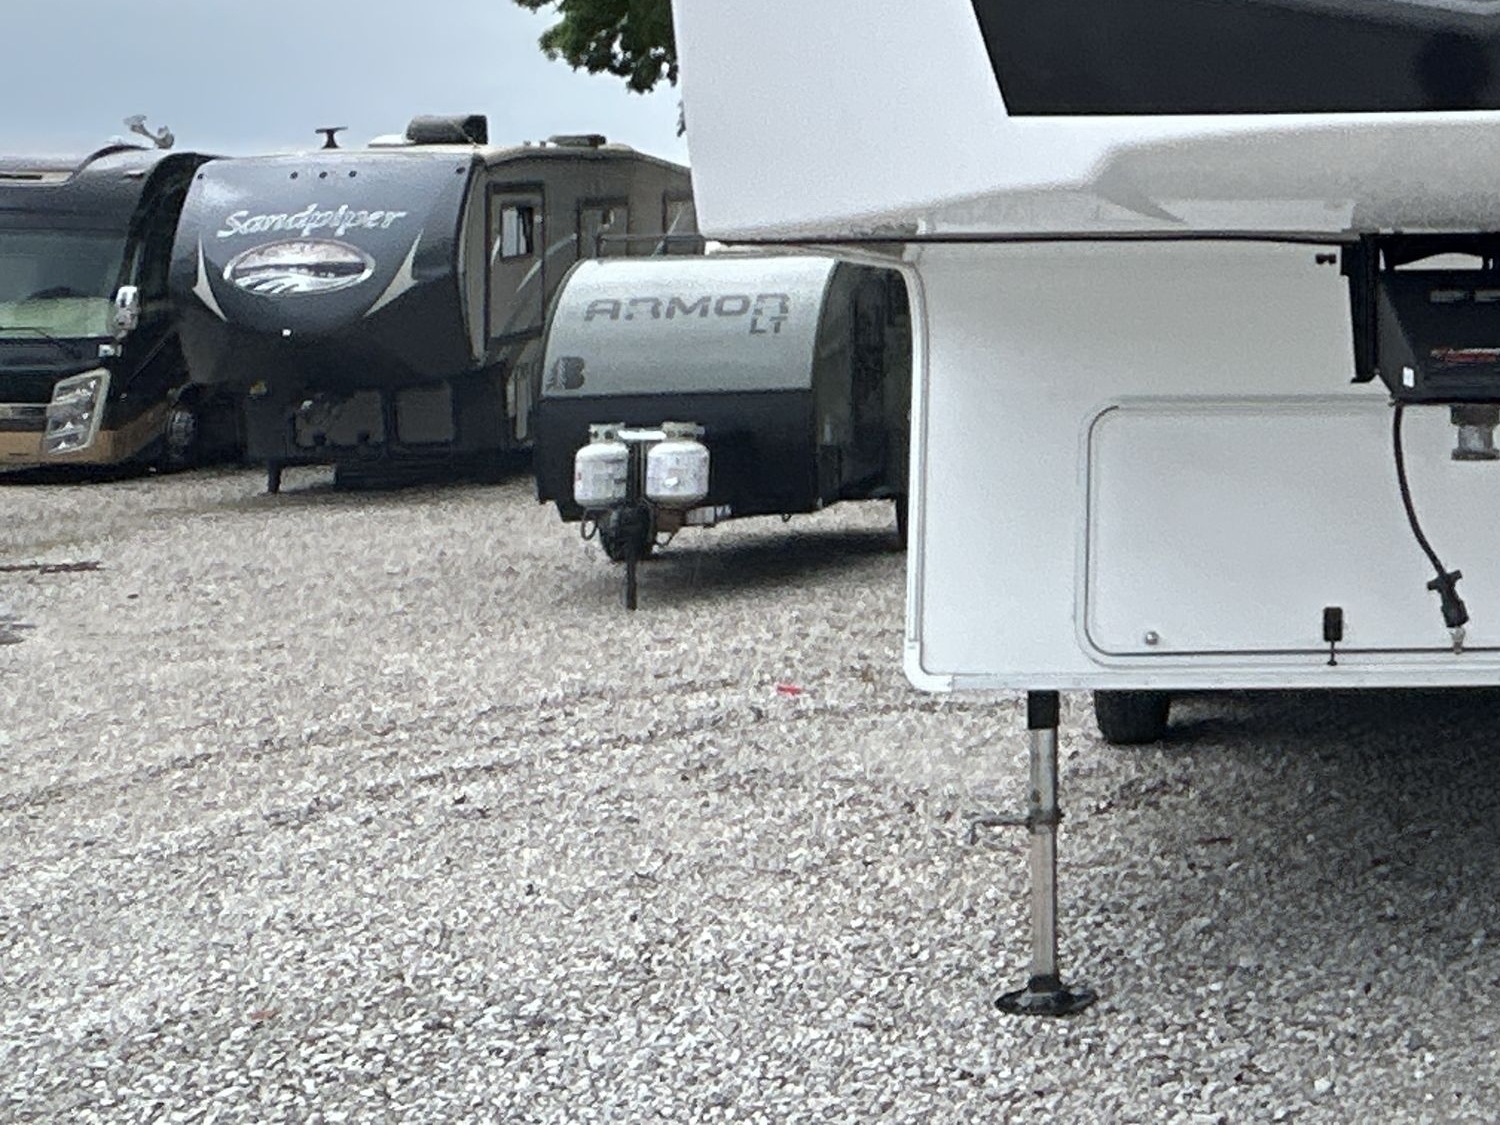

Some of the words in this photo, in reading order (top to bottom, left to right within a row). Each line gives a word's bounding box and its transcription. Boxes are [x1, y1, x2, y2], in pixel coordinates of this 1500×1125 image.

[216, 203, 408, 238] Sandpiper
[584, 292, 790, 322] ARMOR
[750, 316, 788, 334] LT
